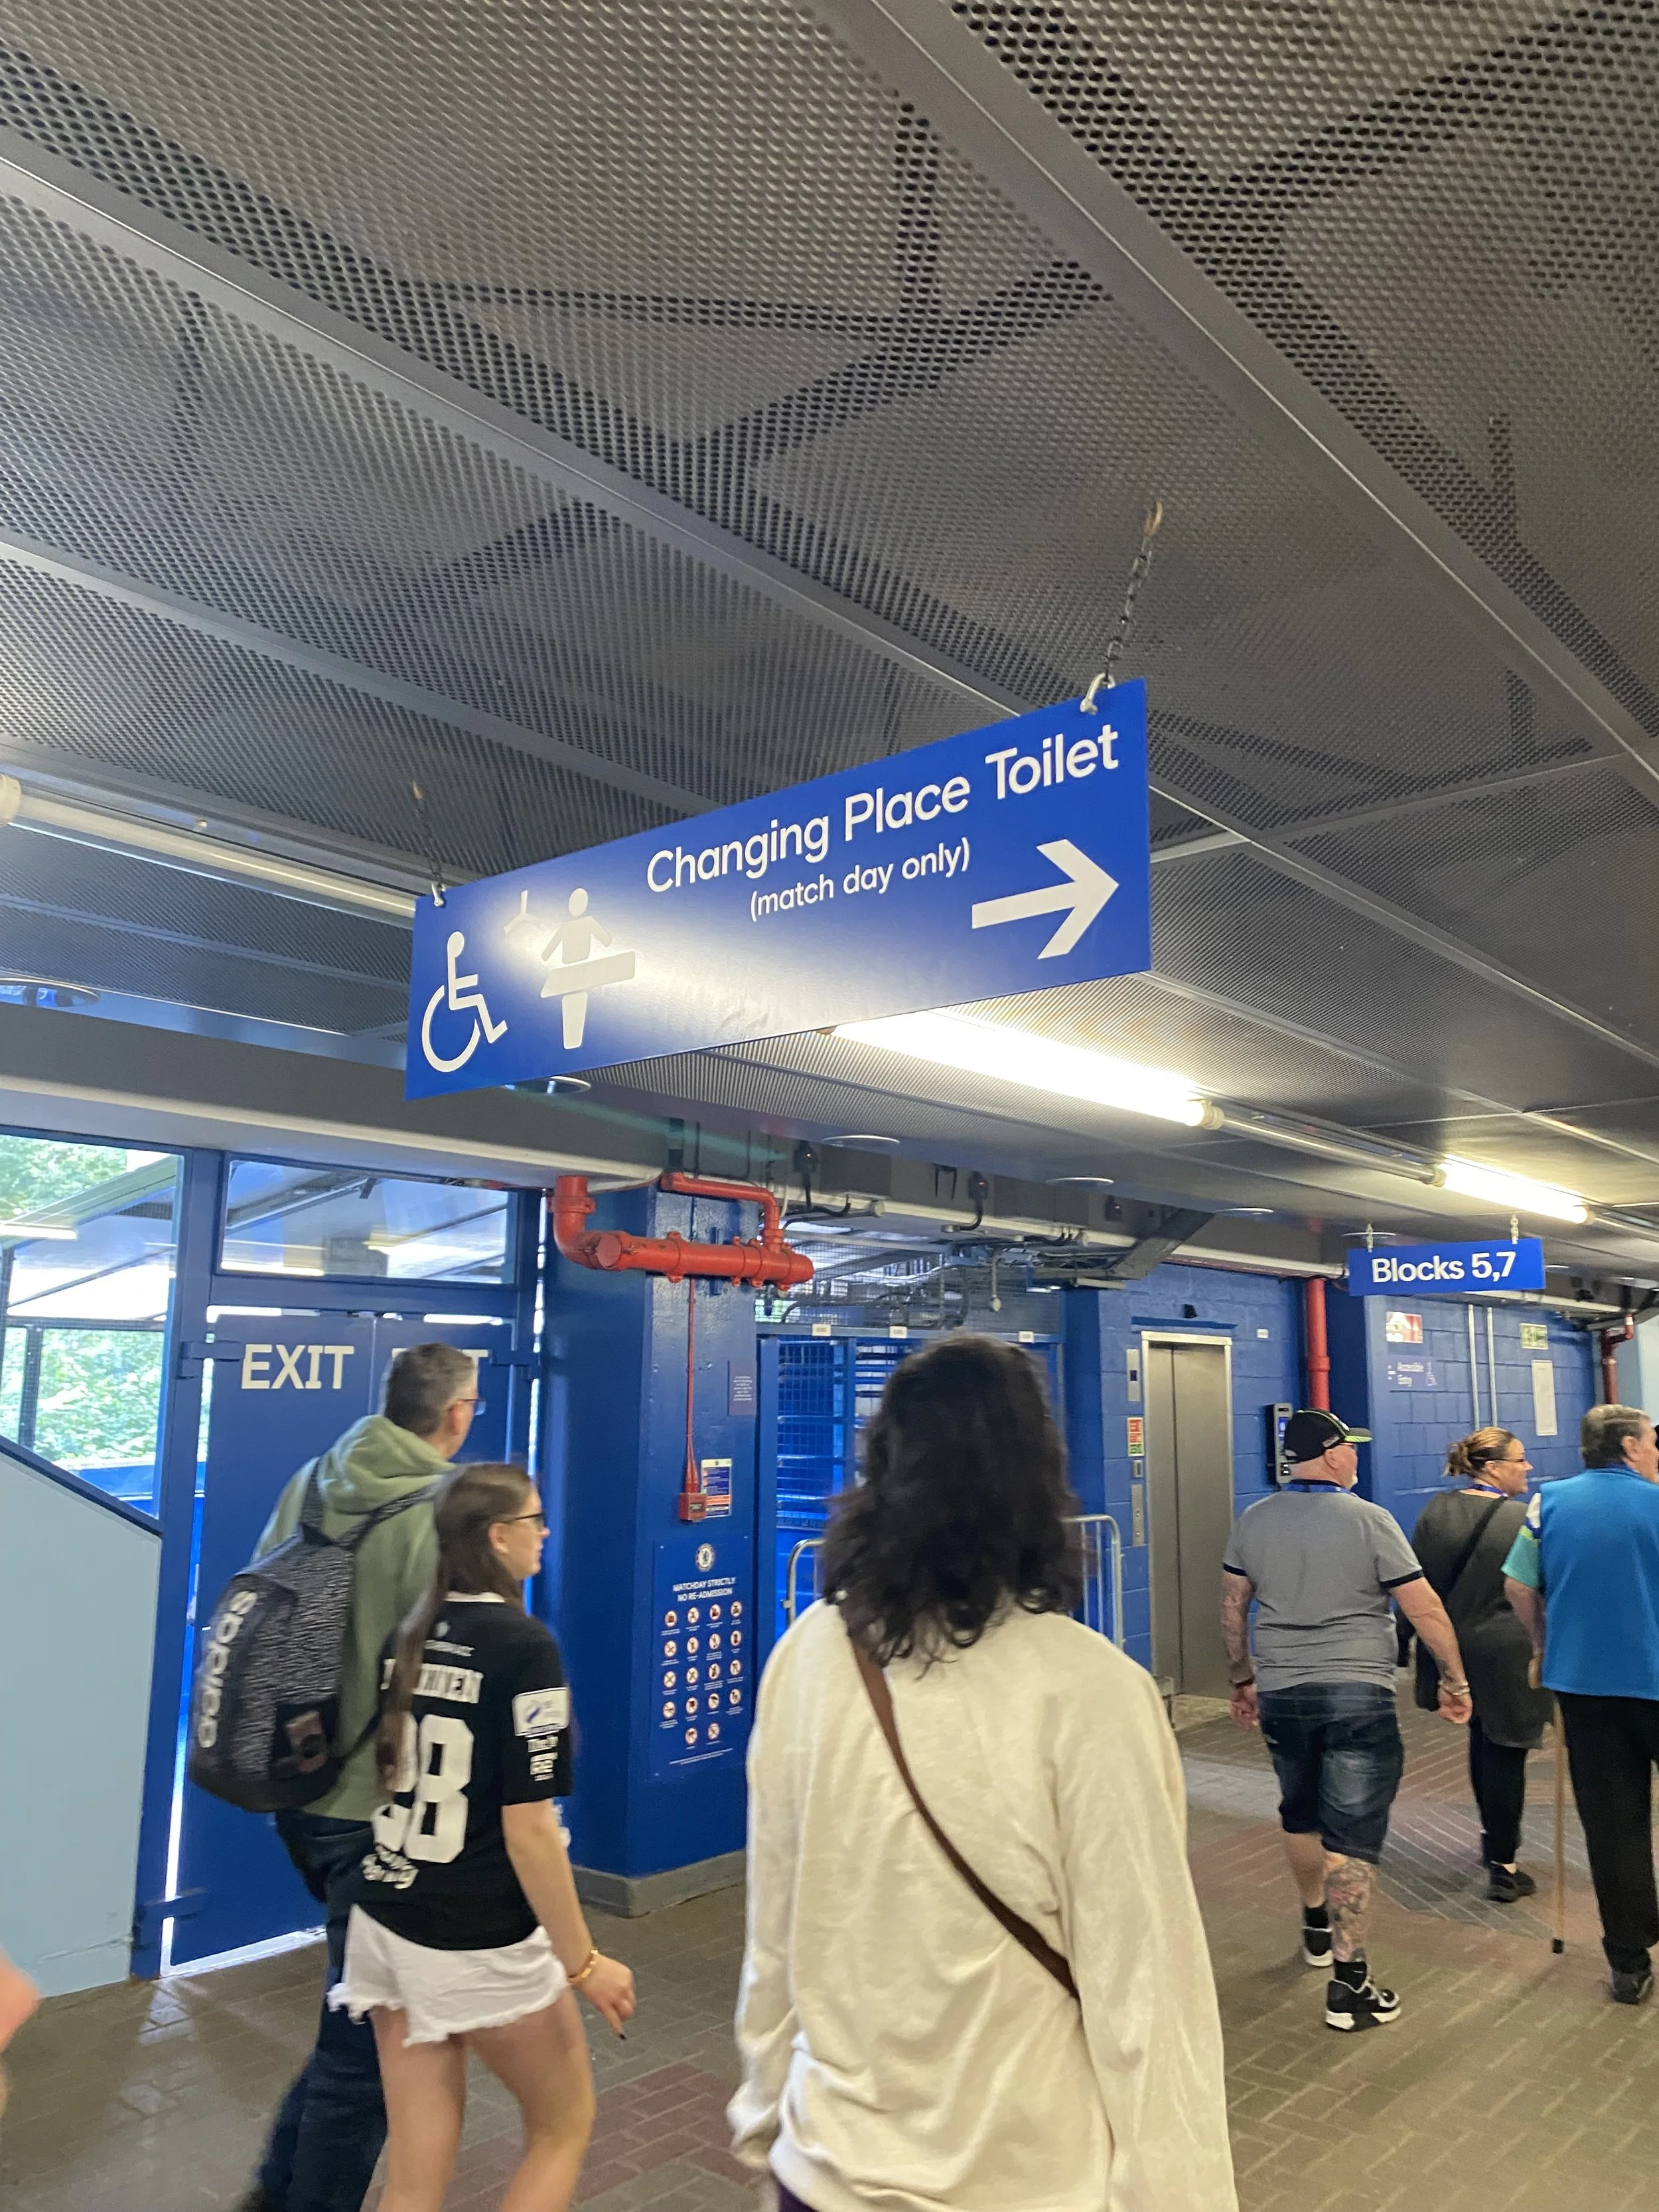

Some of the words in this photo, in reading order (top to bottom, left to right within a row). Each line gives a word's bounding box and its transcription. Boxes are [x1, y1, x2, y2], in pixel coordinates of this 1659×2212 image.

[646, 816, 830, 893] Changing
[845, 775, 971, 842] Place
[985, 723, 1119, 800] Toilet
[750, 873, 835, 922] (match
[843, 863, 893, 896] day
[902, 836, 971, 881] only)
[1371, 1254, 1465, 1284] Blocks
[1471, 1251, 1516, 1282] 5,7
[241, 1343, 355, 1390] EXIT
[672, 1580, 707, 1591] MATCHDAY
[707, 1577, 736, 1587] STRICTLY
[677, 1593, 687, 1601] NO
[688, 1587, 733, 1600] RE-ADMISSION
